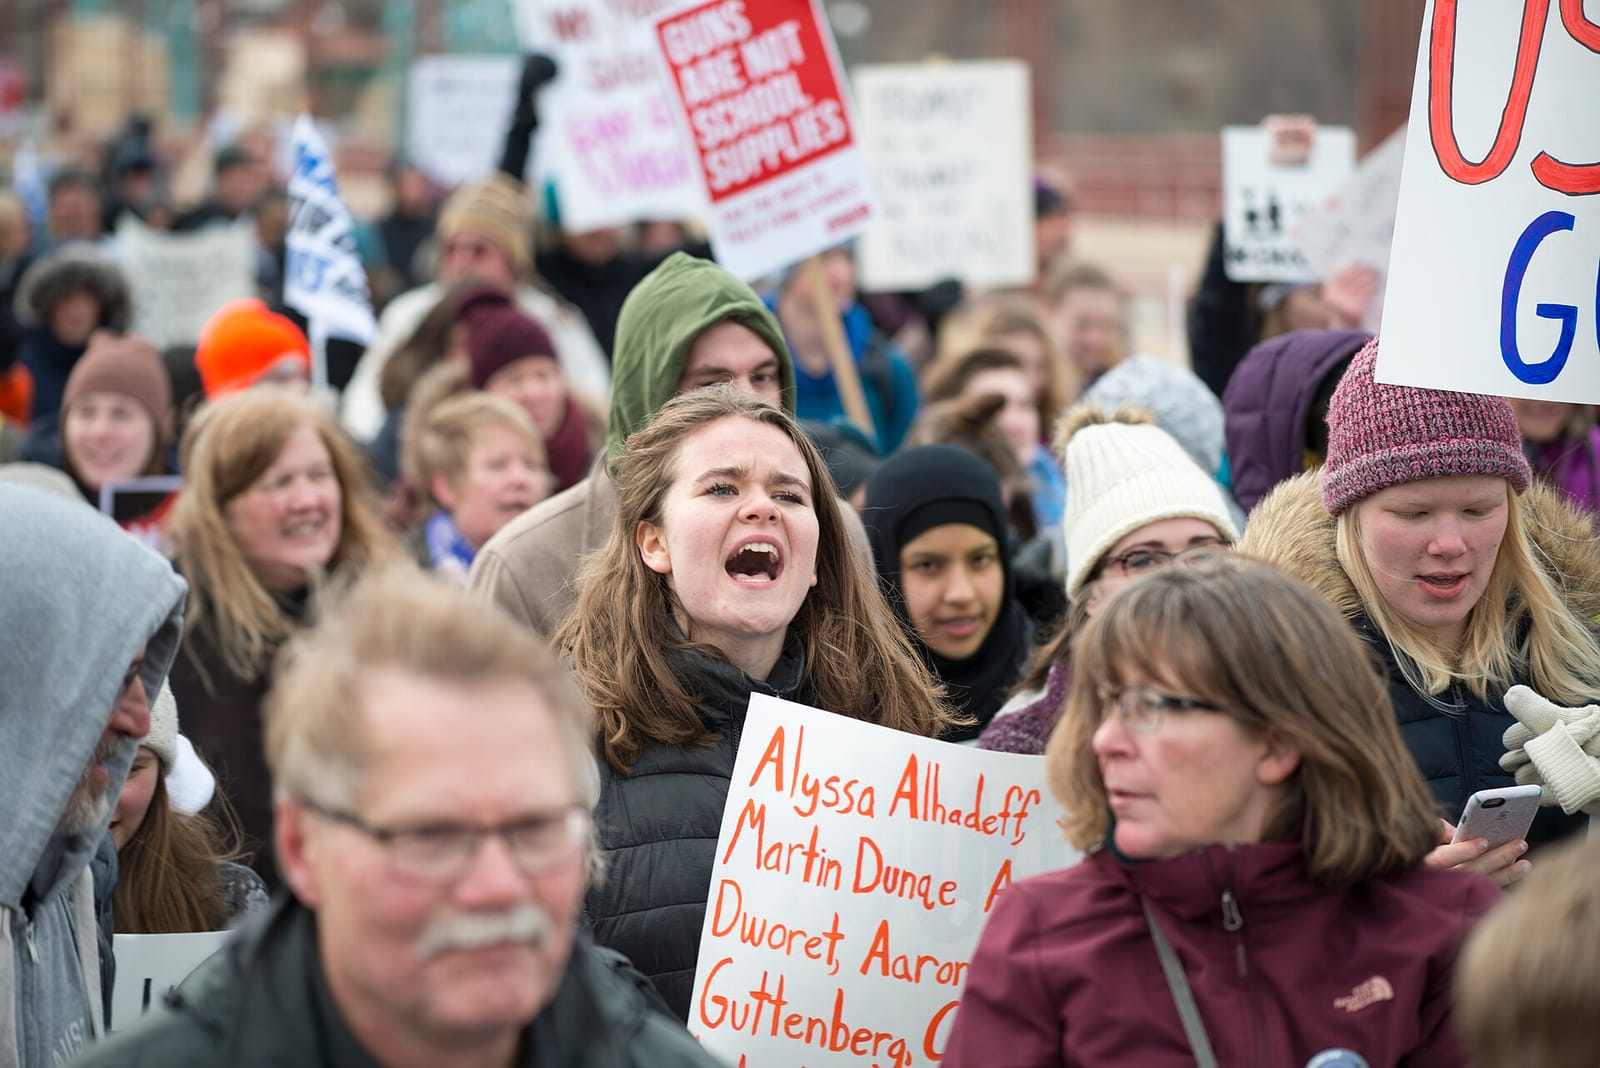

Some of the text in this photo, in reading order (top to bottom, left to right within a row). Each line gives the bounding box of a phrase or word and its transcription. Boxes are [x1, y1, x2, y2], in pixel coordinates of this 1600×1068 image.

[662, 1, 752, 65] GUNS
[678, 45, 749, 105] ARE
[740, 20, 805, 80] NOT
[691, 70, 815, 149] SCHOOL
[704, 98, 848, 191] SUPPLIES
[1500, 210, 1600, 385] G
[748, 724, 1041, 846] Alyssa Alhadeff,
[722, 798, 842, 891] Martin
[711, 879, 970, 986] Dworet, Aaron
[699, 957, 913, 1068] Guttenberg,
